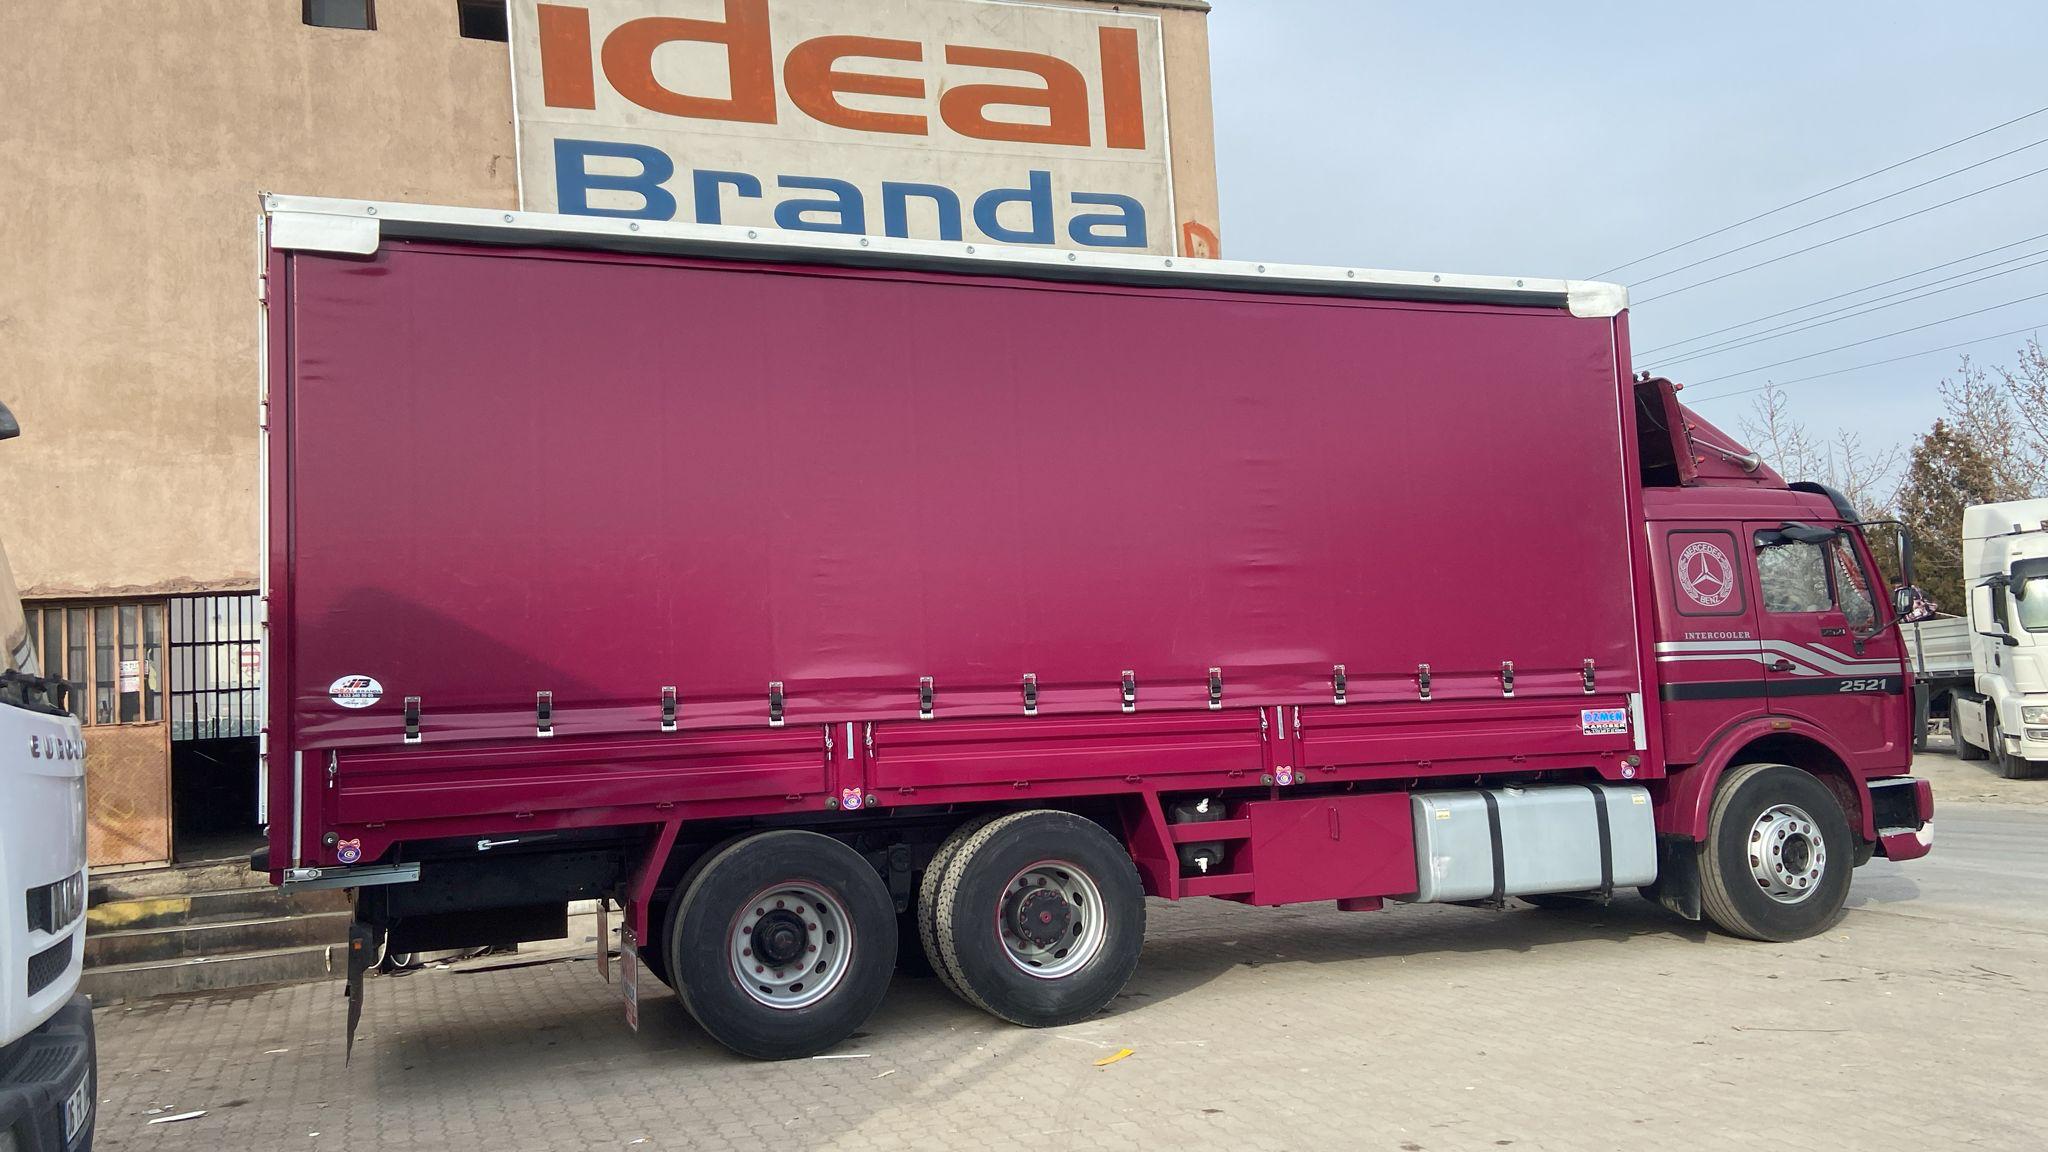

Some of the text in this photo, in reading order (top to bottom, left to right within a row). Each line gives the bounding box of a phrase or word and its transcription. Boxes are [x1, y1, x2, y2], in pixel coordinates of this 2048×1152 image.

[553, 138, 1148, 248] Branda
[1683, 543, 1723, 560] MERCEDES
[1699, 595, 1721, 605] BENZ
[1684, 631, 1751, 640] INTERCOOLER
[1840, 678, 1887, 692] 2521
